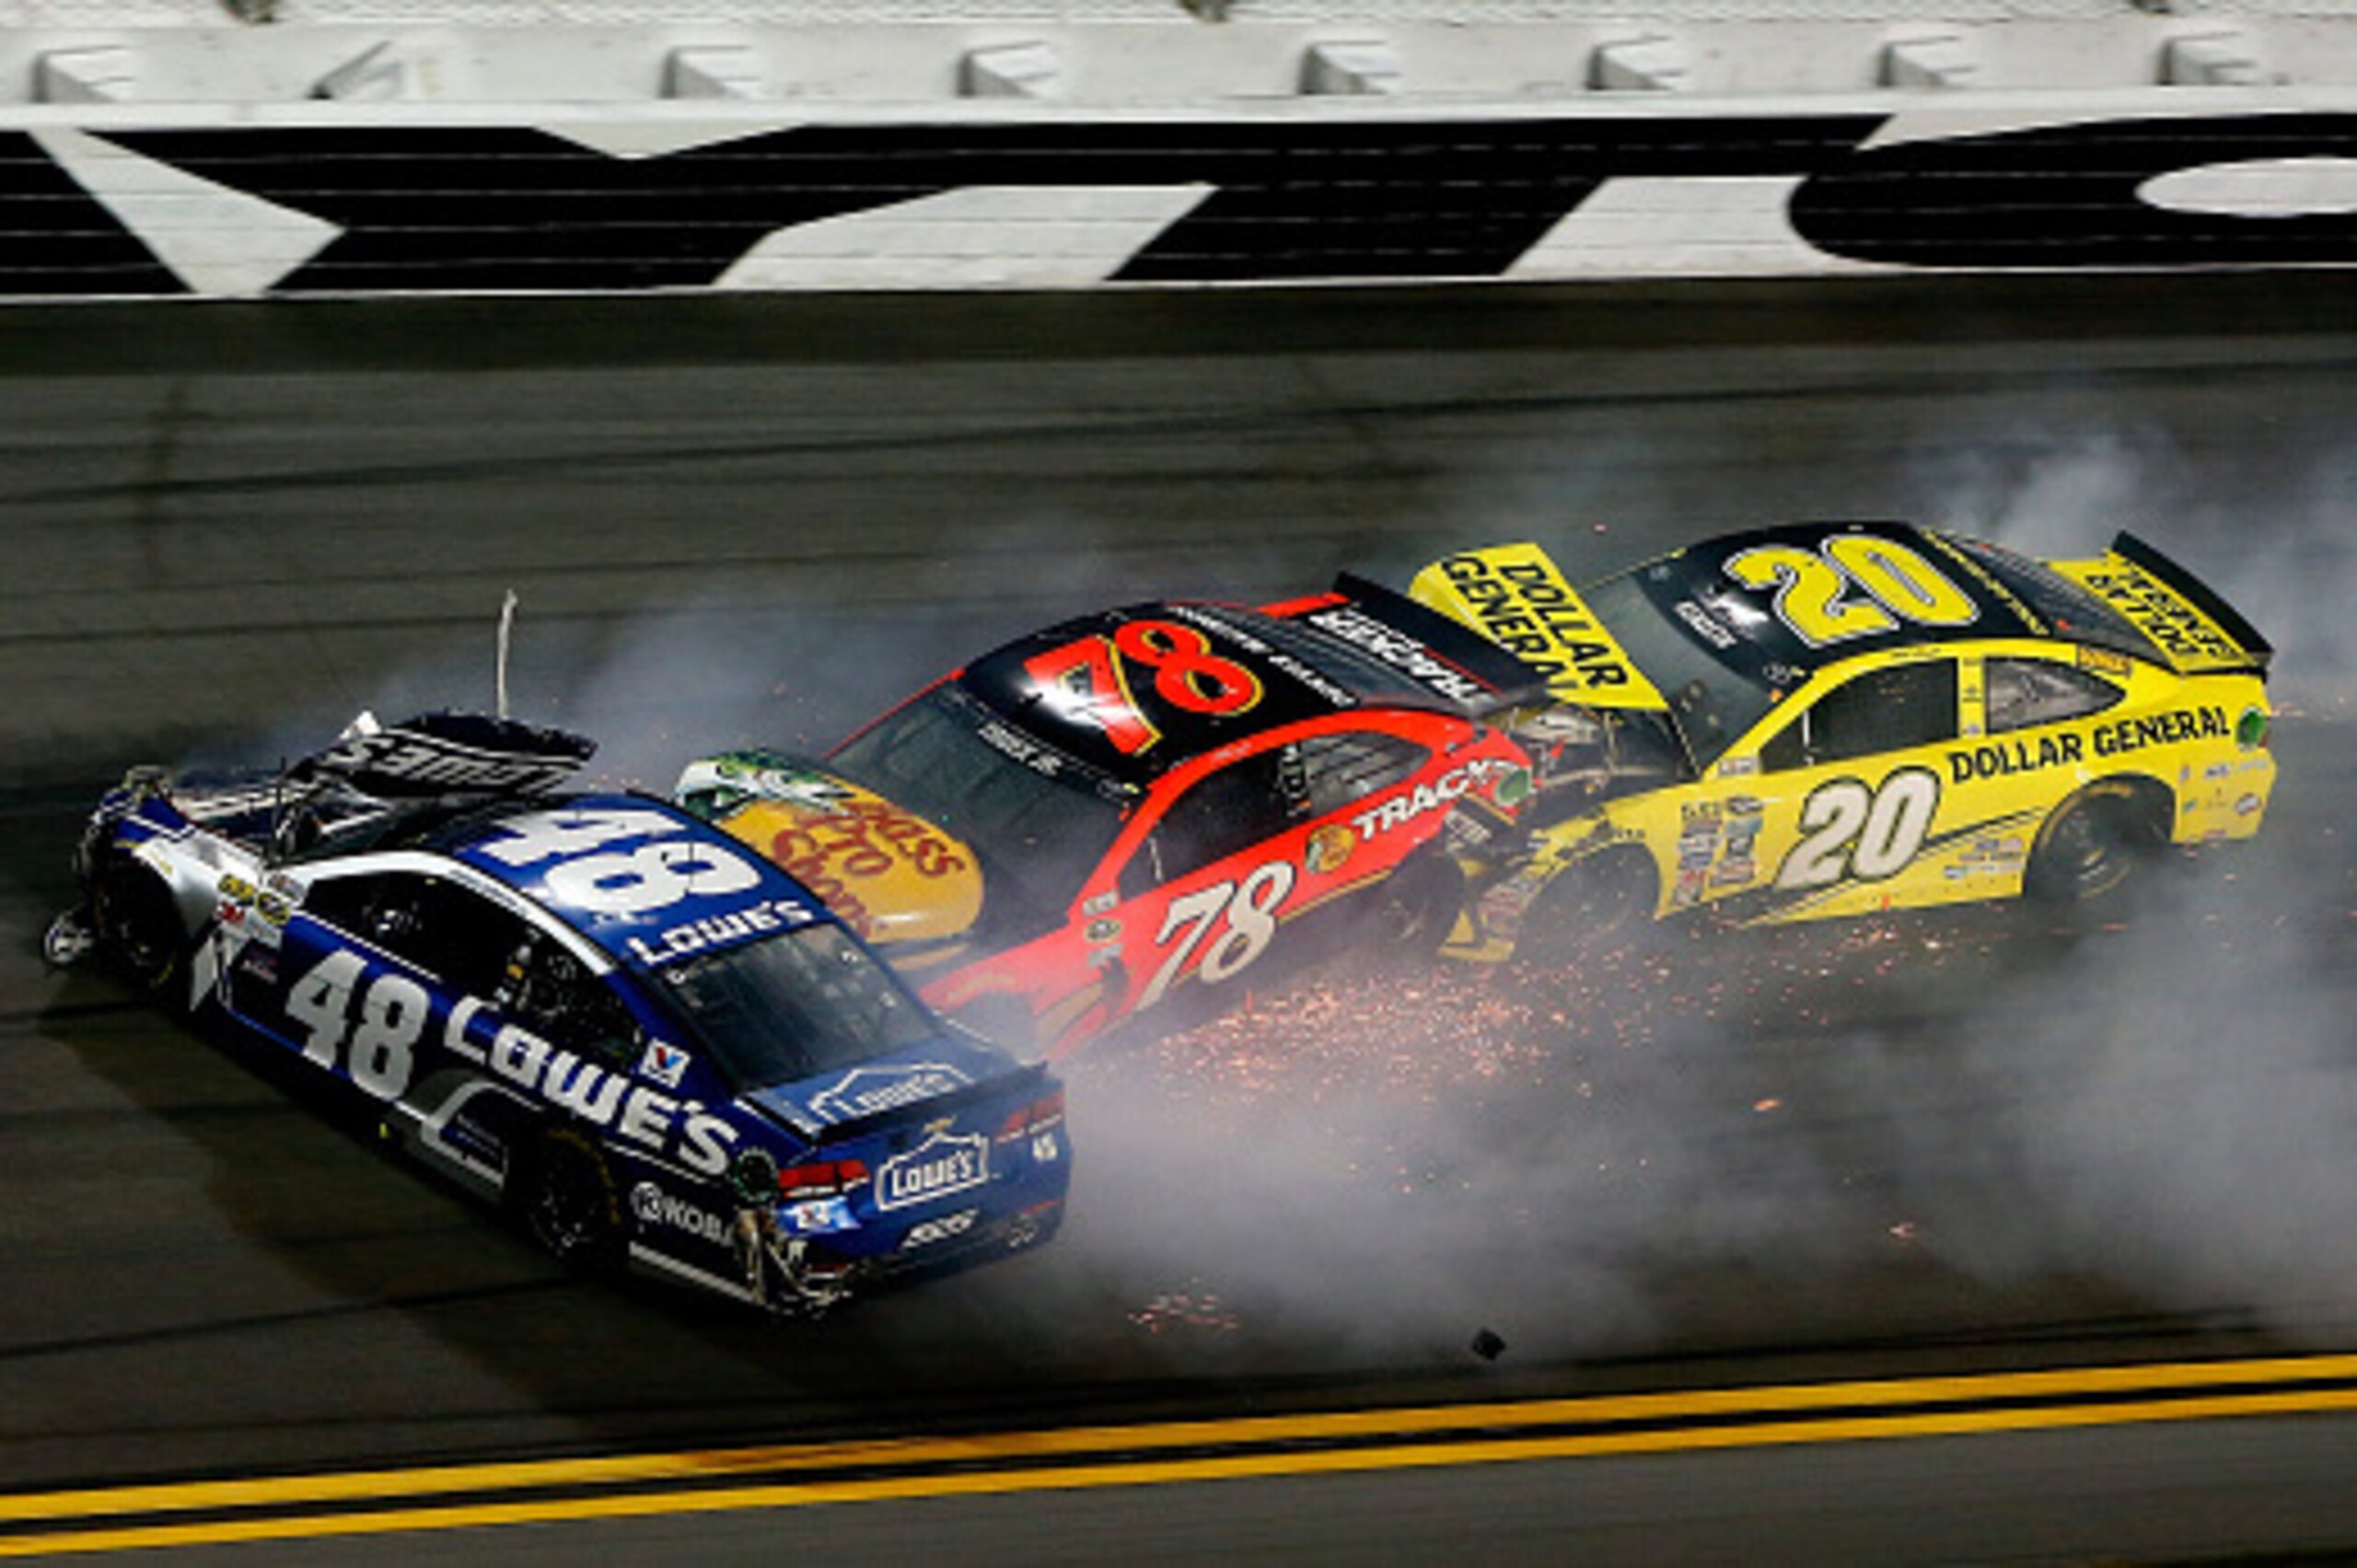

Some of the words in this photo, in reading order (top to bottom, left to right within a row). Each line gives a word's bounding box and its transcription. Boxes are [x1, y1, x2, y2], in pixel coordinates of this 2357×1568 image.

[1496, 563, 1628, 689] DOLLAR
[1722, 531, 1981, 650] 20
[1022, 619, 1265, 755] 78
[1946, 731, 2084, 784] DOLLAR
[2092, 704, 2232, 757] GENERAL
[477, 808, 763, 915] 48
[1773, 766, 1943, 890] 20
[626, 899, 815, 967] LOWE'S
[1134, 861, 1295, 1011] 78
[284, 949, 431, 1101] 48
[442, 994, 739, 1176] LOWE'S
[890, 1149, 972, 1197] LOWE'S
